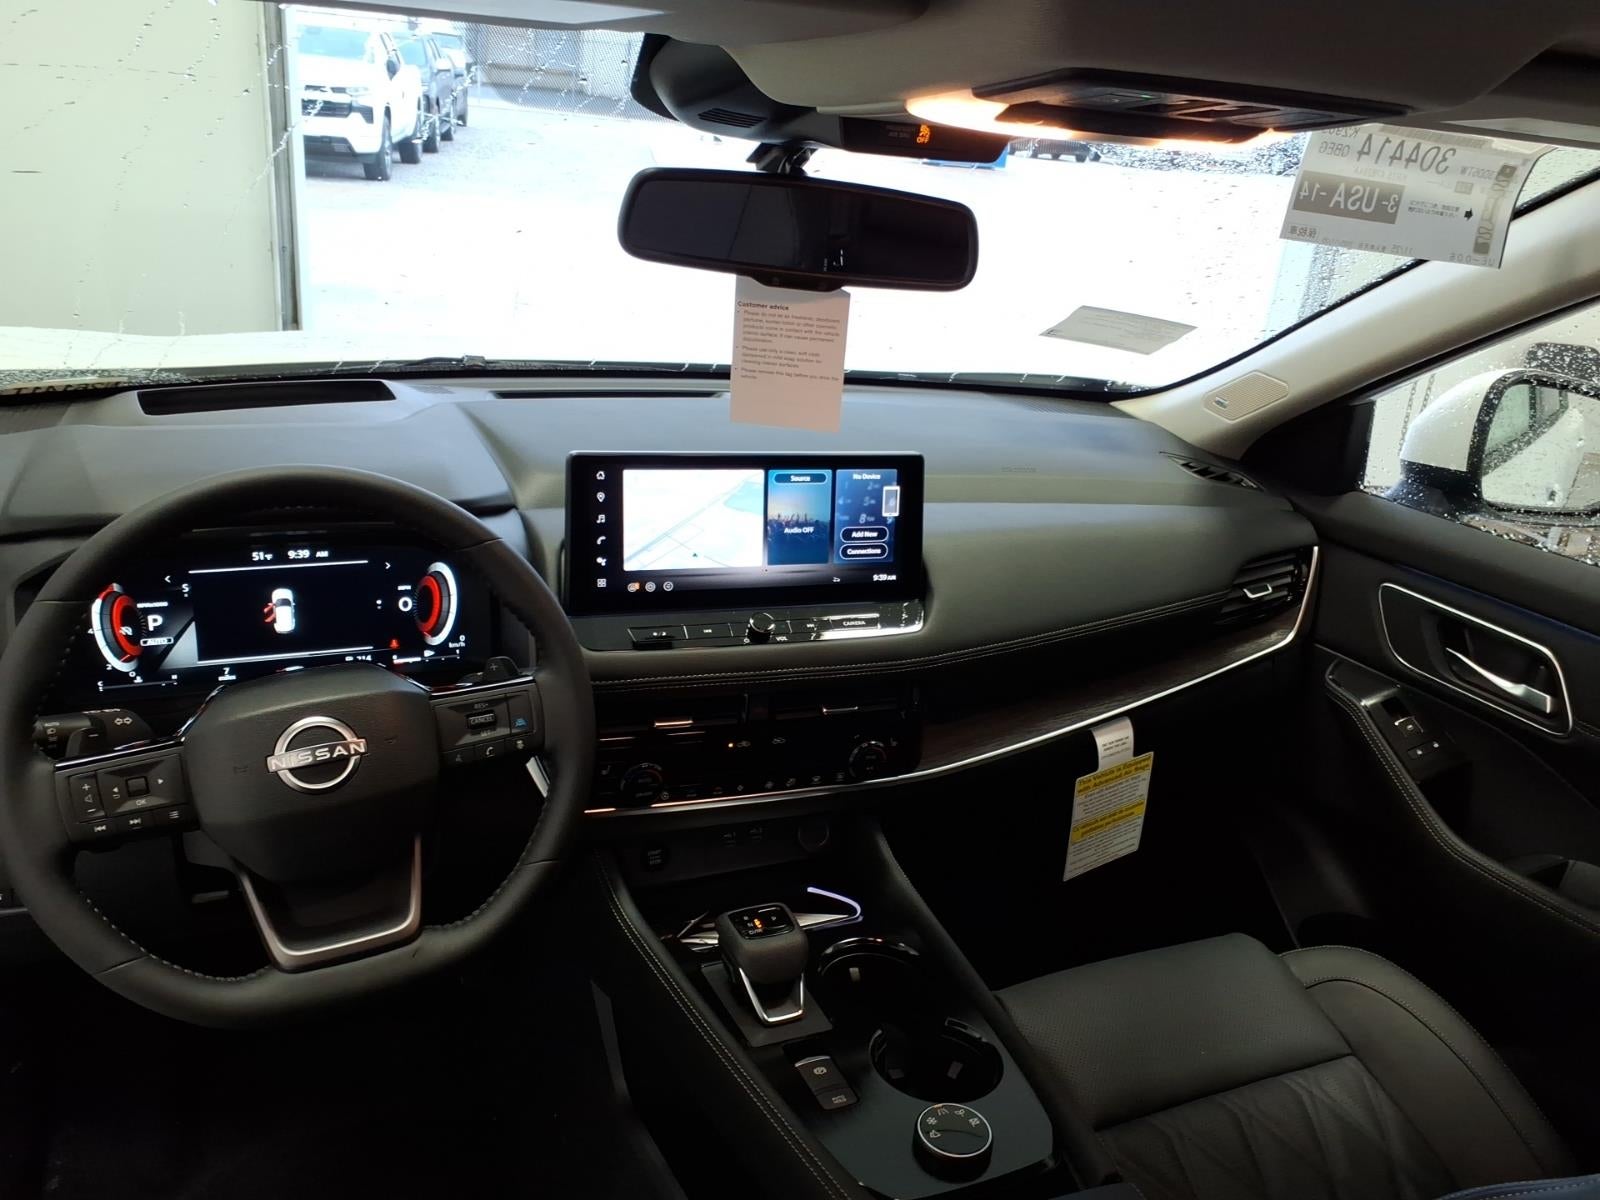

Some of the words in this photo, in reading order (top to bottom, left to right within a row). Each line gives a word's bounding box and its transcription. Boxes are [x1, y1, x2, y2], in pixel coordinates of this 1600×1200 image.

[737, 300, 768, 308] Customer
[769, 303, 789, 311] advice
[790, 474, 811, 482] Source
[784, 527, 802, 535] Audio
[802, 526, 815, 534] OFF
[287, 550, 310, 560] 9:39
[847, 547, 881, 555] Connections
[147, 614, 163, 631] P
[271, 742, 366, 770] NISSAN
